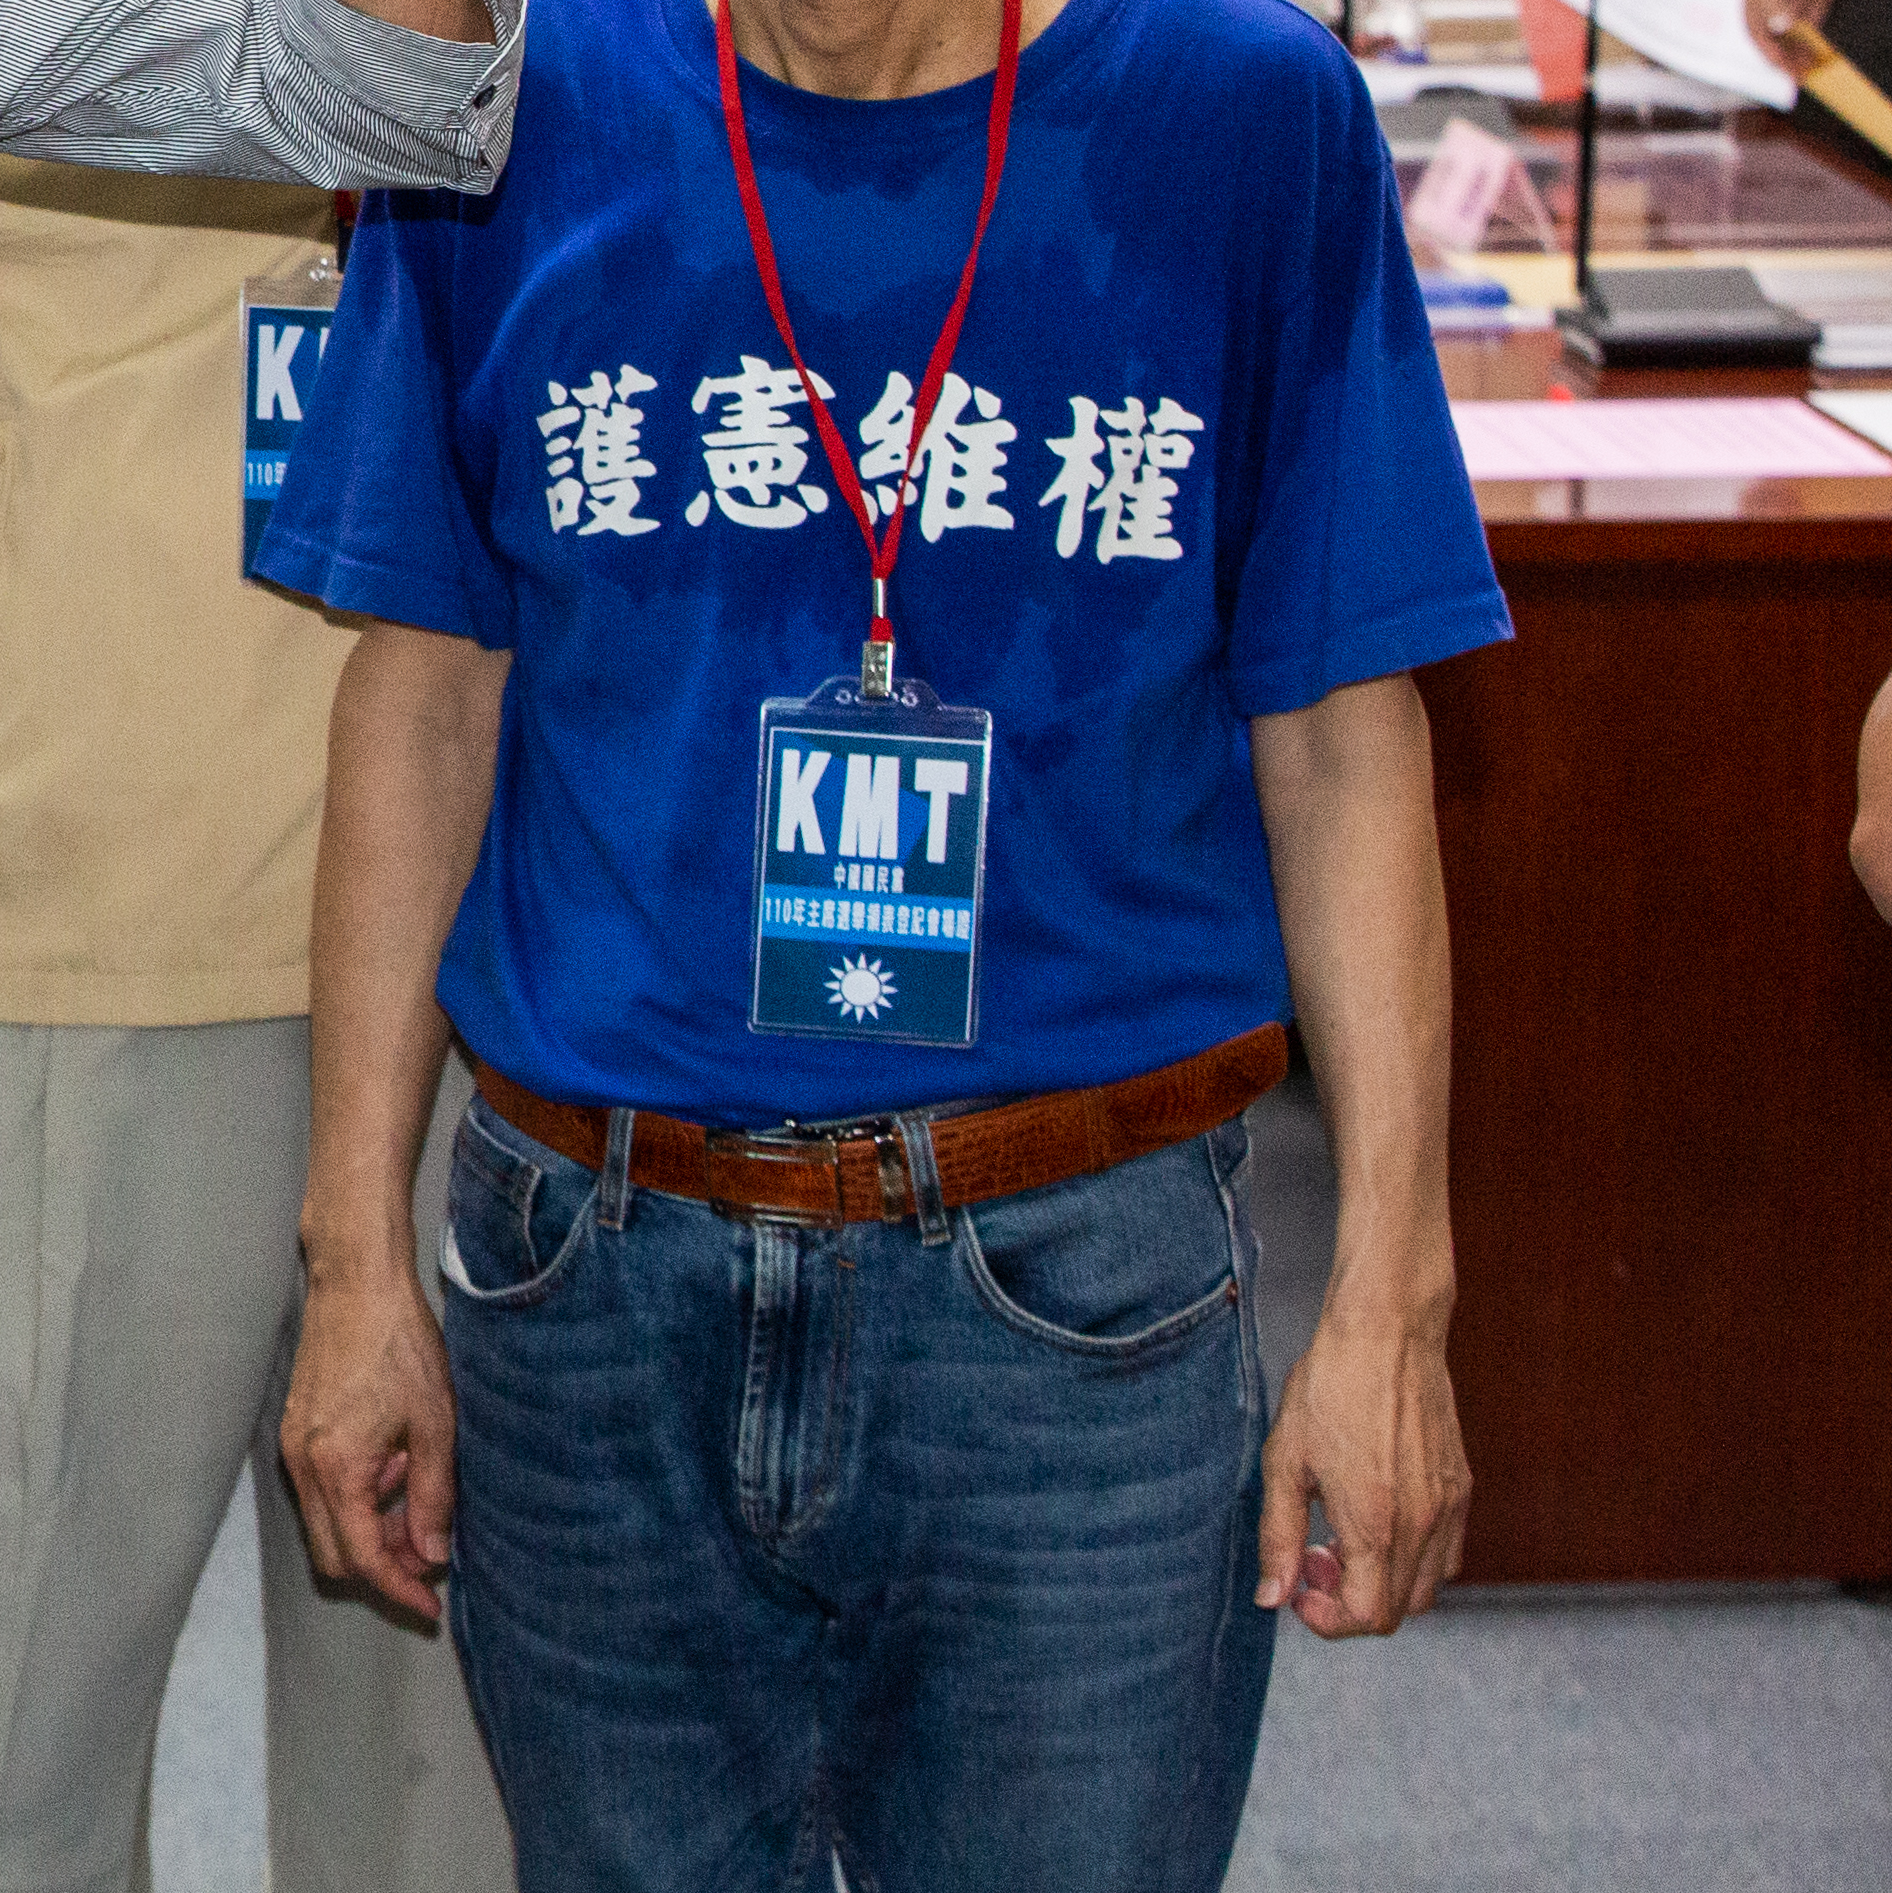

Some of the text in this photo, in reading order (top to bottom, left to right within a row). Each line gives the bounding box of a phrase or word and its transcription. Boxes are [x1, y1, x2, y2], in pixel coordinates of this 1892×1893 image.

[536, 355, 1205, 564] 護憲維權
[775, 749, 969, 865] KMT
